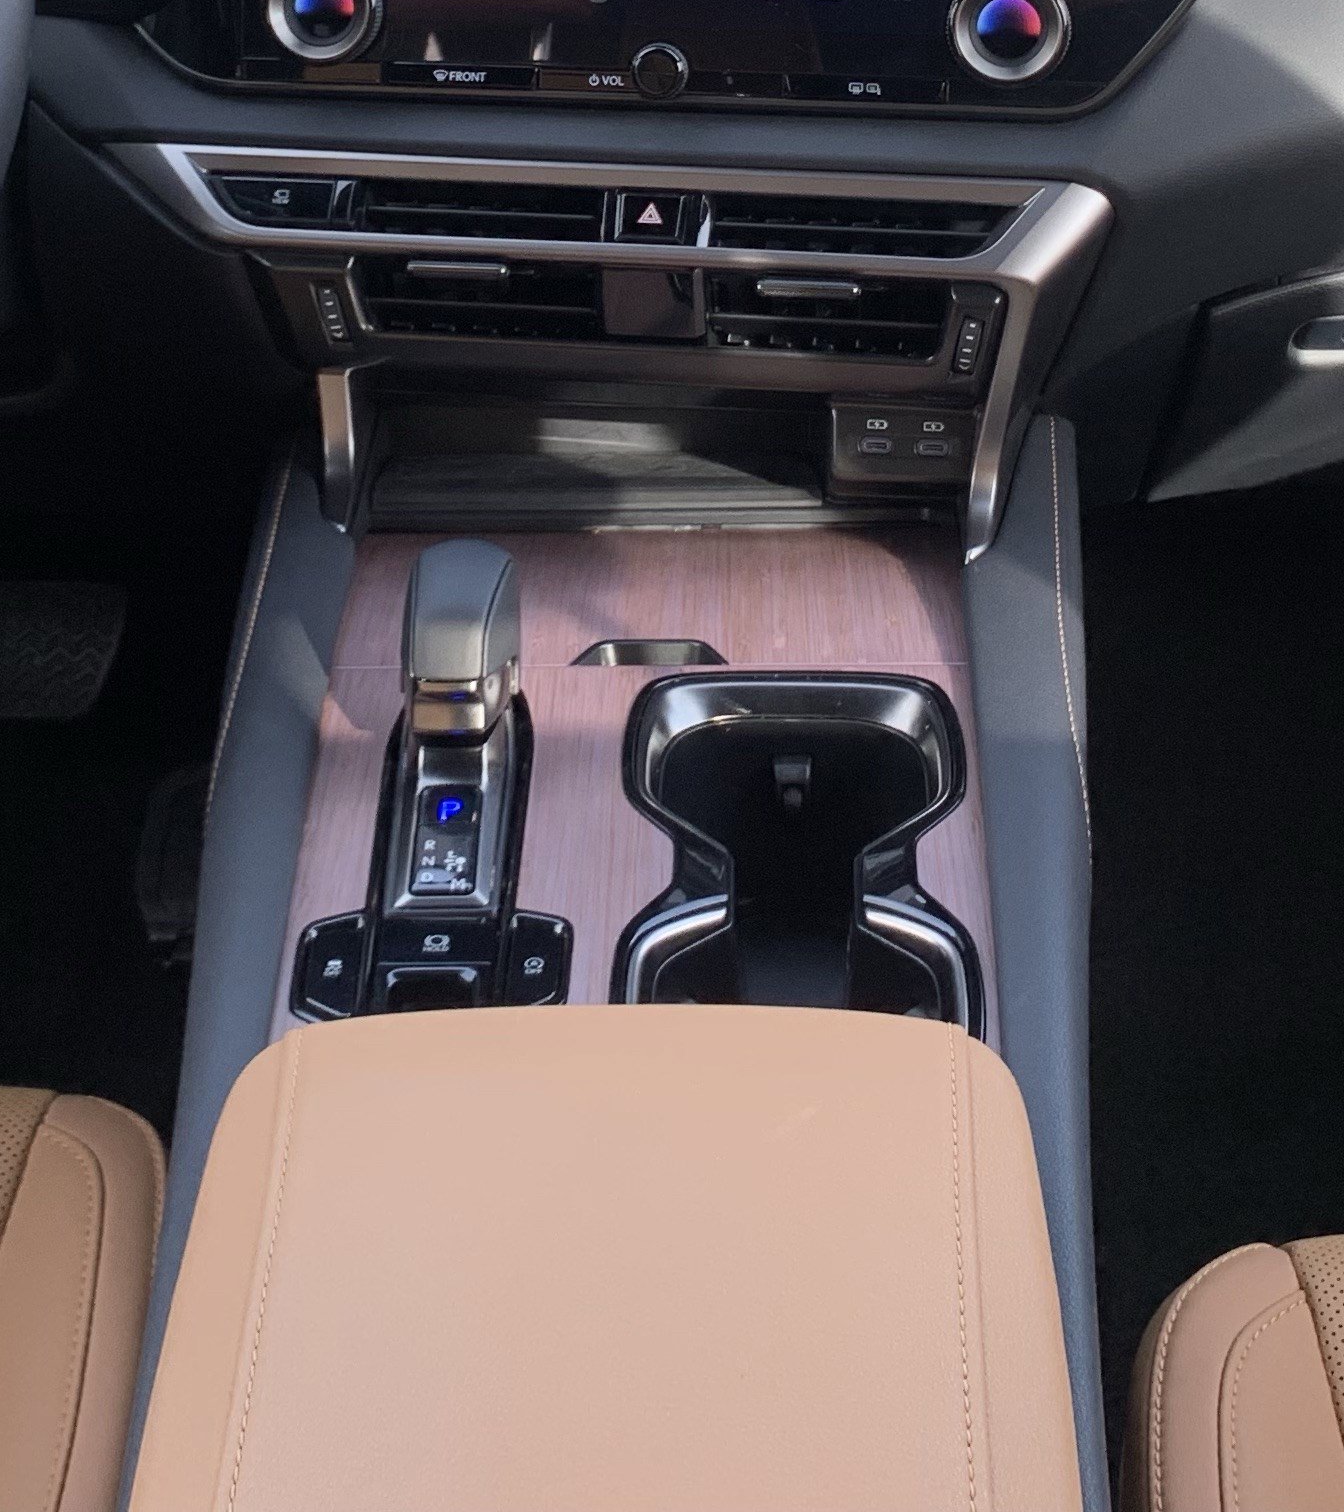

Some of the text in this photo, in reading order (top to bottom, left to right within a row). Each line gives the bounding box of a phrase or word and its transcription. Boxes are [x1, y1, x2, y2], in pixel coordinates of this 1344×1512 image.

[449, 71, 487, 83] FRONT
[601, 75, 624, 86] VOL
[439, 800, 462, 822] P
[424, 839, 436, 850] R
[421, 856, 436, 866] N
[420, 872, 434, 883] D
[449, 877, 467, 891] M
